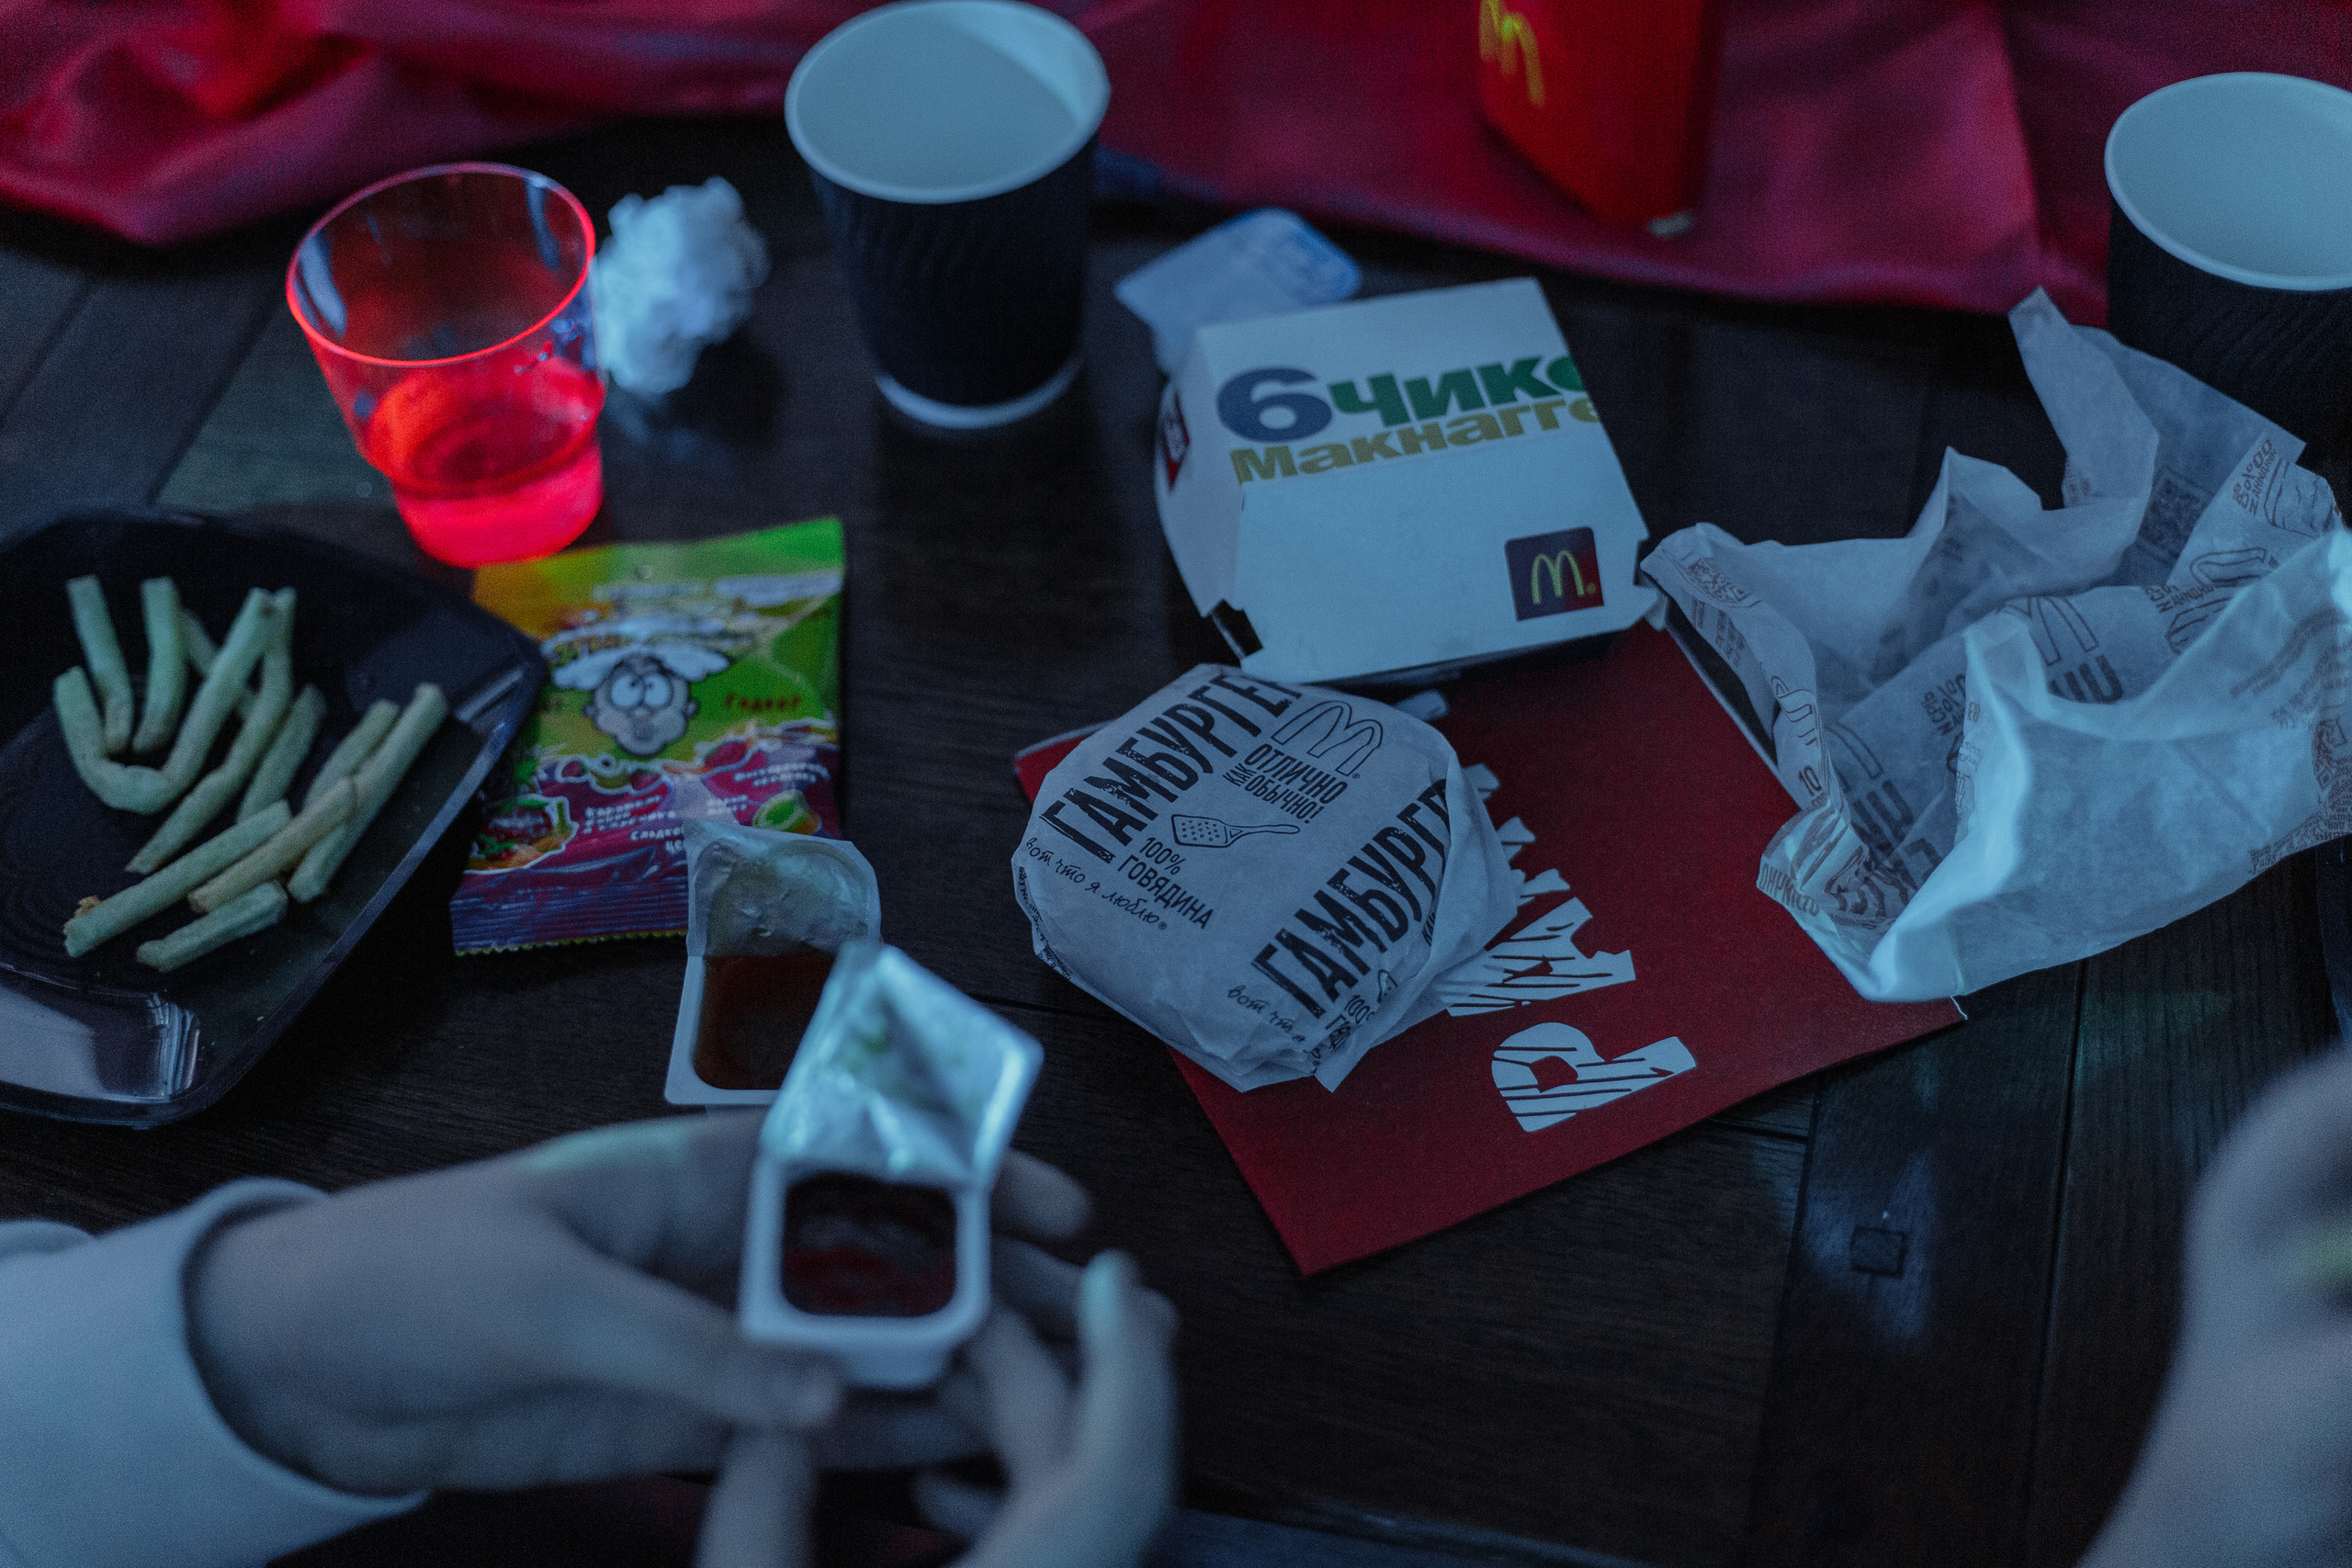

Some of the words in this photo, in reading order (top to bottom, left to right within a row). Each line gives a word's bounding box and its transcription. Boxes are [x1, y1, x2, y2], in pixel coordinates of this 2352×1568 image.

[1217, 367, 1332, 442] 6
[1039, 674, 1302, 863] ГАМБУРГЕ
[1222, 762, 1258, 787] КАК
[1244, 774, 1325, 824] ОБЫЧНО!
[1244, 743, 1348, 805] ОТЛИЧНО
[1026, 837, 1055, 866] вот
[1055, 858, 1086, 884] что
[1084, 881, 1101, 894] я
[1139, 837, 1186, 875] 100%
[1117, 854, 1214, 930] ГОВЯДИНА
[1251, 778, 1451, 1020] ГАМБУРГ
